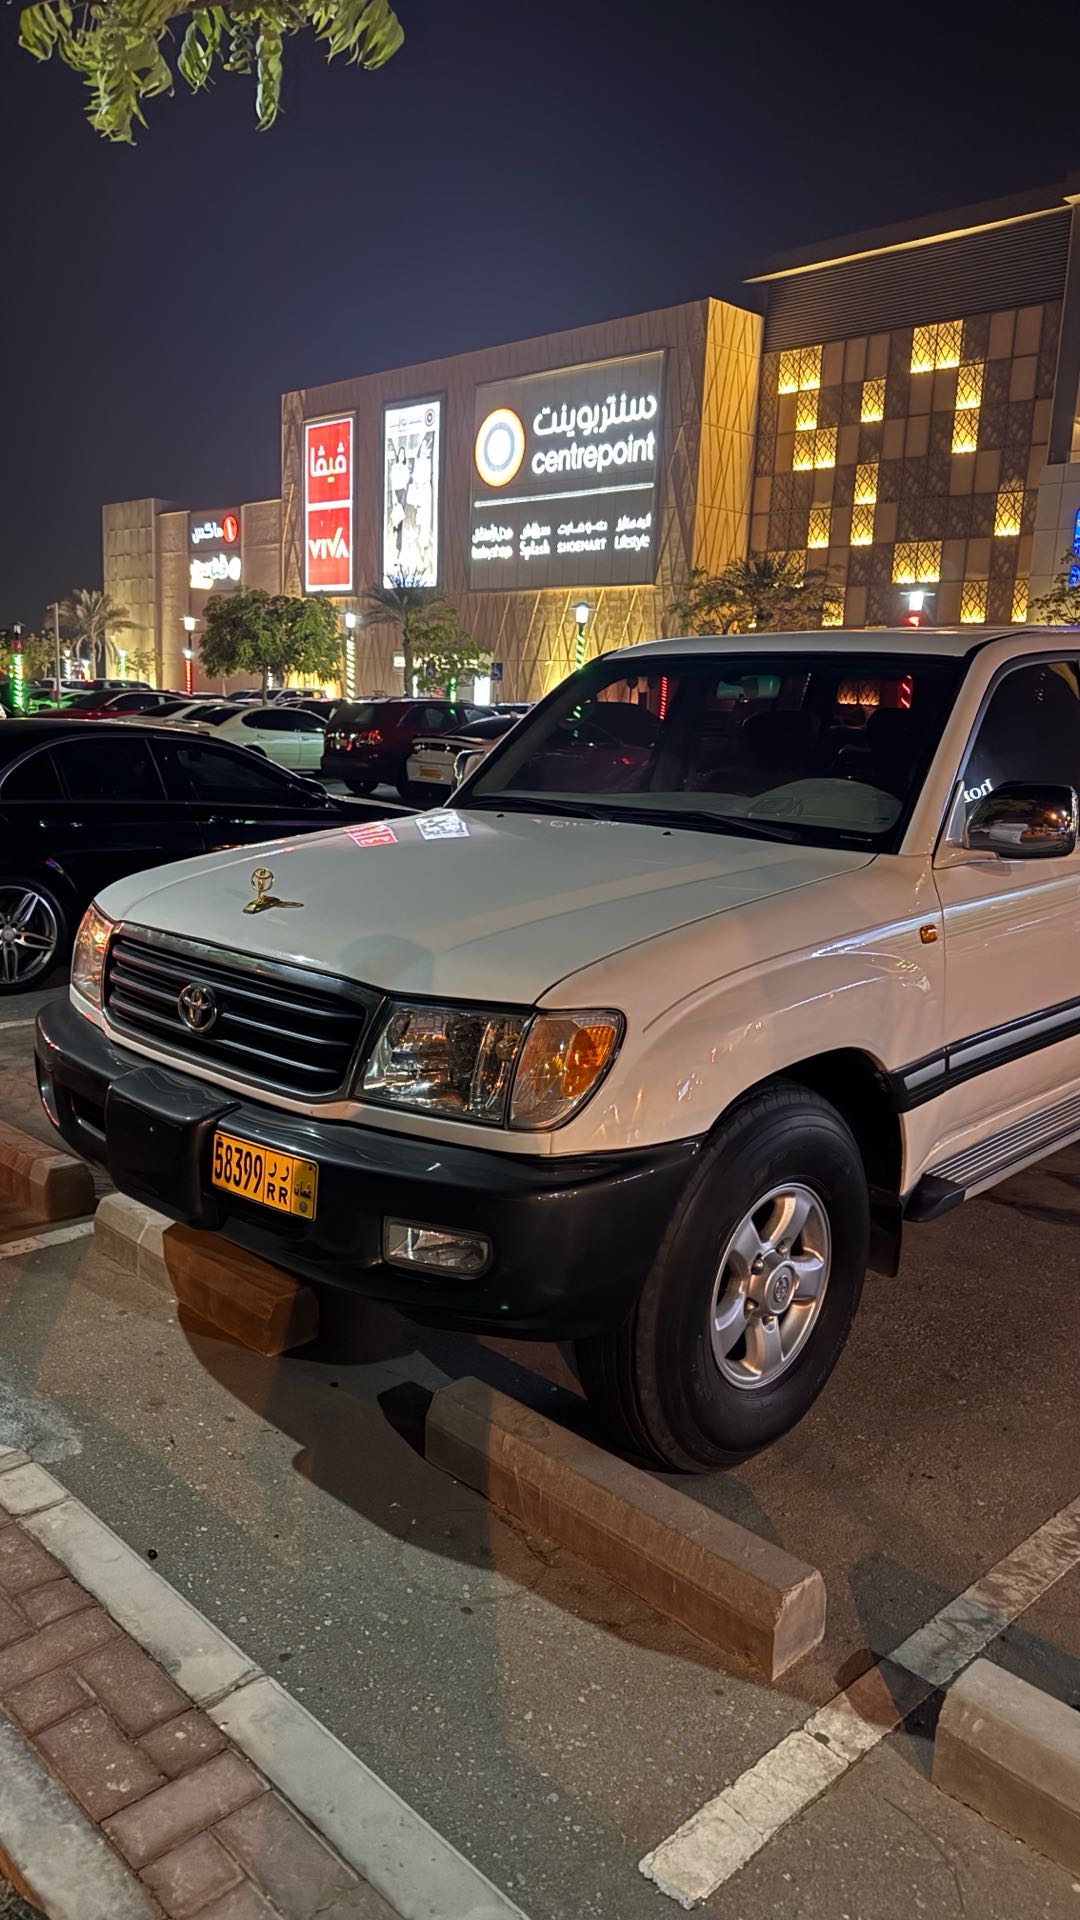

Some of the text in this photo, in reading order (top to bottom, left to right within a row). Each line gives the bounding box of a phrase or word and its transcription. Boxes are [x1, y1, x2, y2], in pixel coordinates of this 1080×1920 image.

[533, 391, 657, 437] سنتربوينت
[531, 430, 656, 475] centrepoint
[308, 527, 350, 560] VIVA
[214, 1138, 263, 1194] 58399
